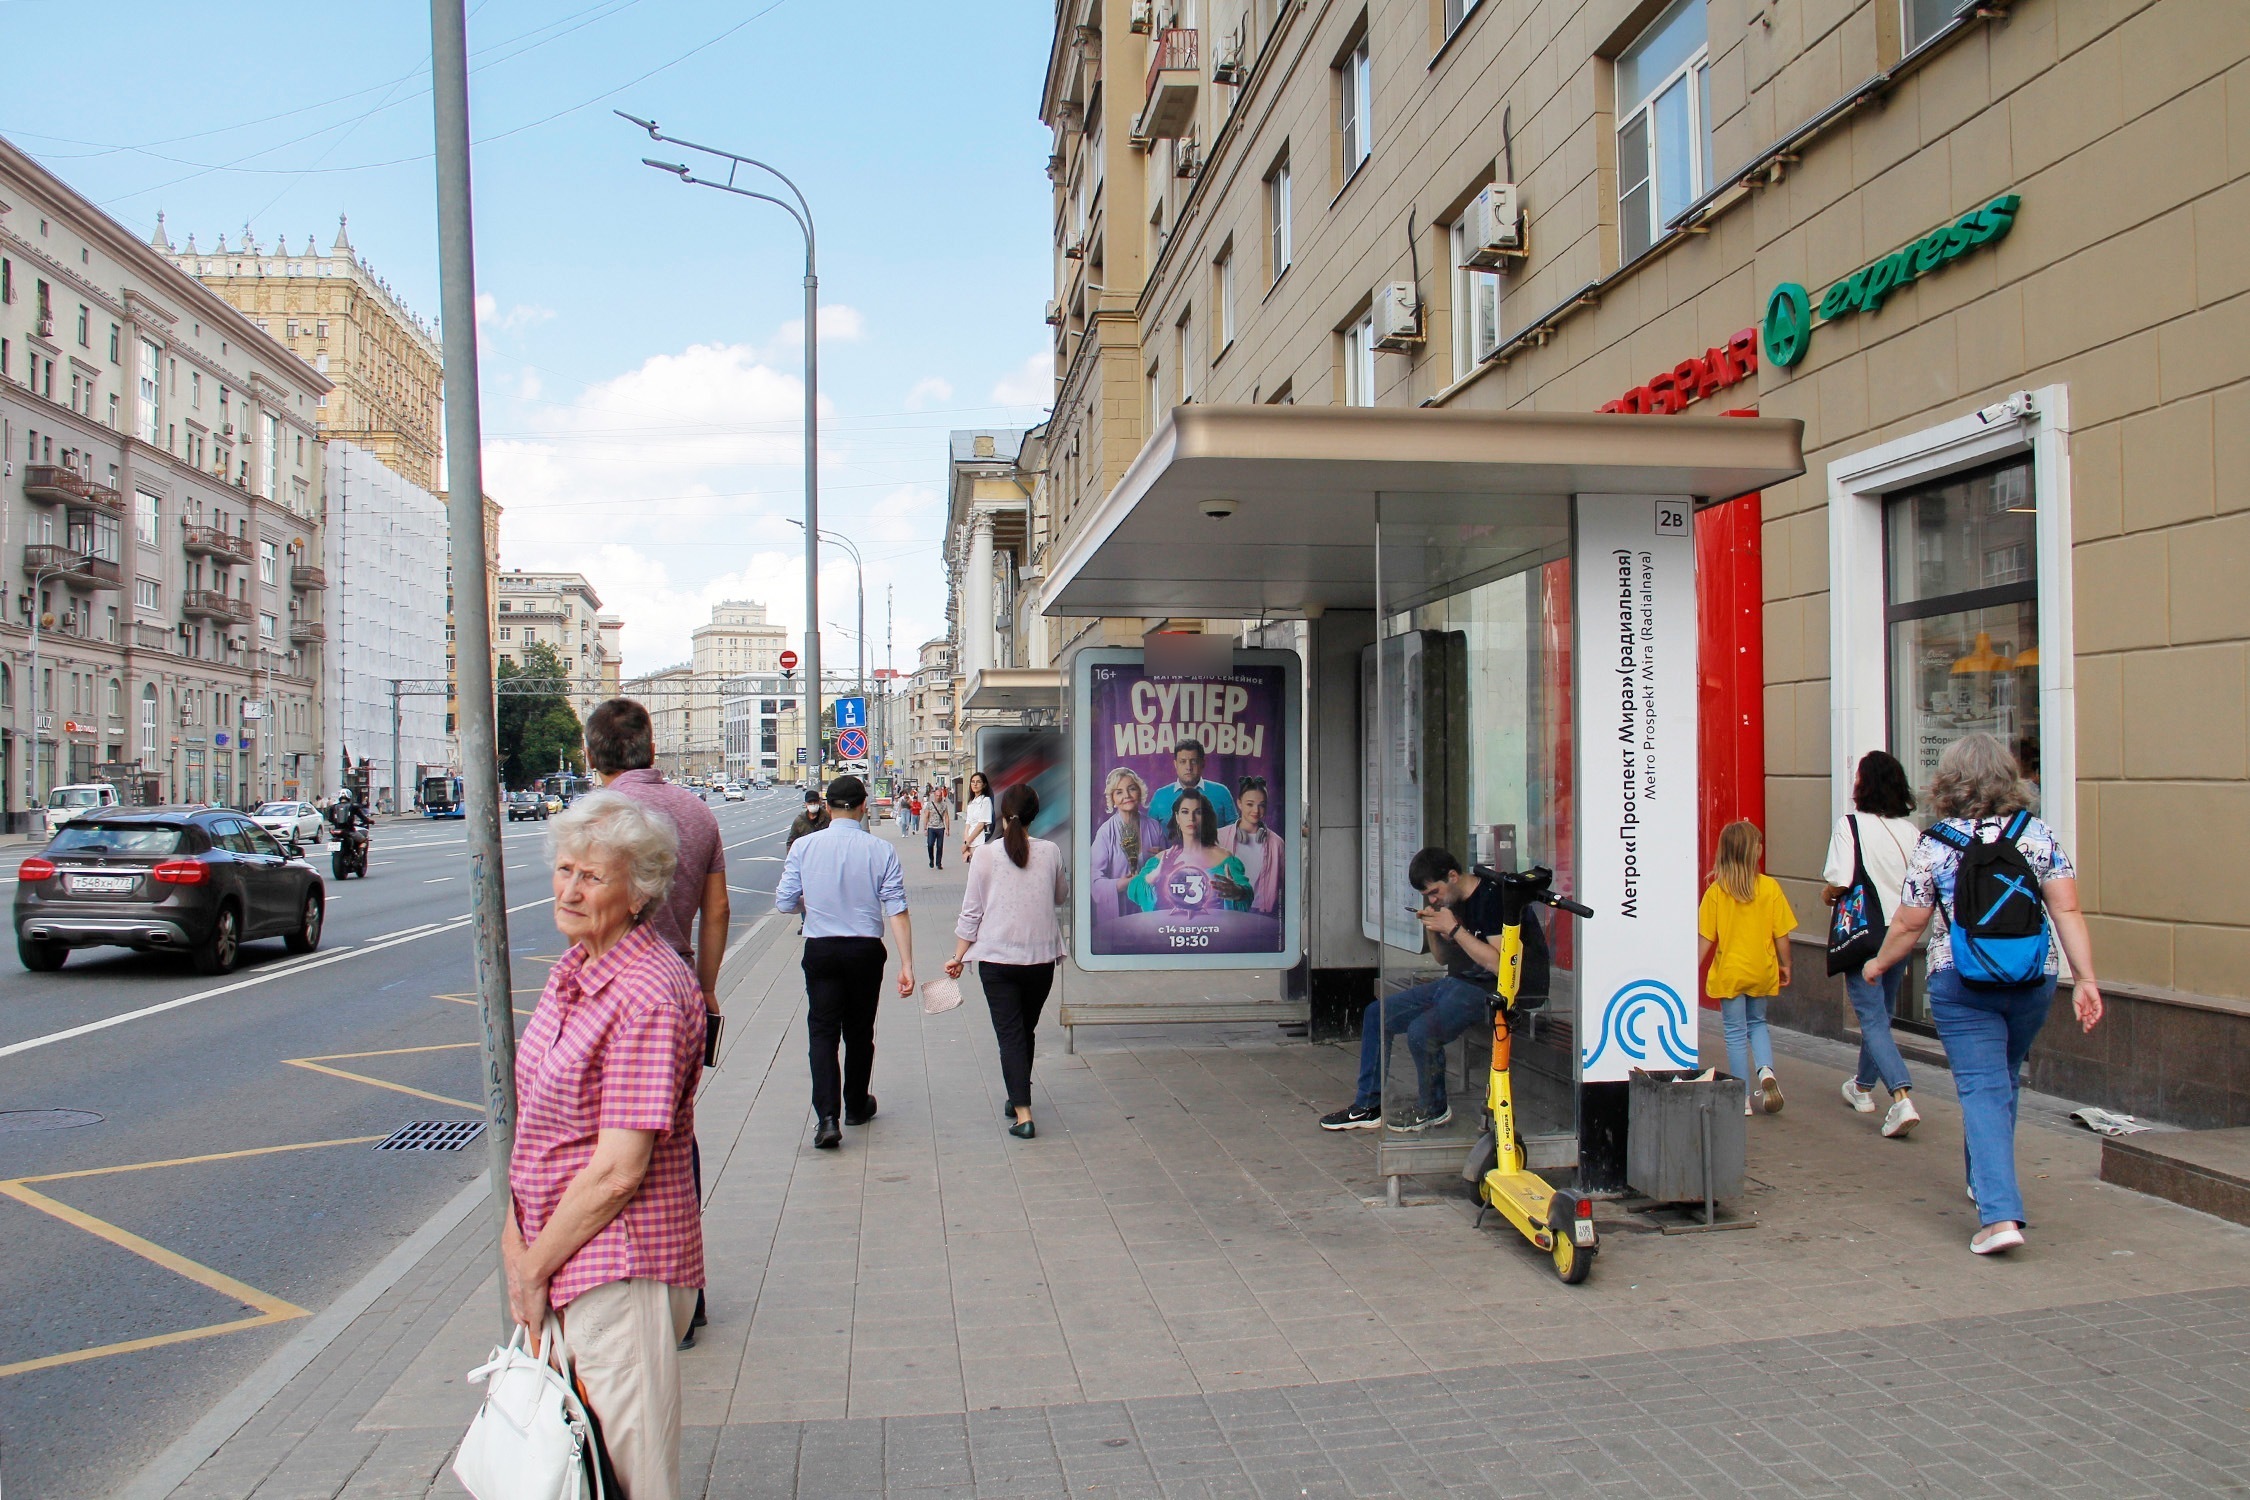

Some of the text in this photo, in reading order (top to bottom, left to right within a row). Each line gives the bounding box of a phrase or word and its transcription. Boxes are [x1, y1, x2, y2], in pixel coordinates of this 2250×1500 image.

[1818, 194, 2021, 321] express
[1095, 669, 1117, 680] 16+
[1217, 675, 1263, 684] СЕМЕЙНОЕ
[1639, 552, 1657, 799] Metro Prospekt Mira (Radialnaya)
[1131, 680, 1248, 724] СУПЕР
[1114, 722, 1264, 758] ИВАНОВЫ
[1169, 935, 1209, 947] 19:30
[1179, 926, 1220, 935] августа
